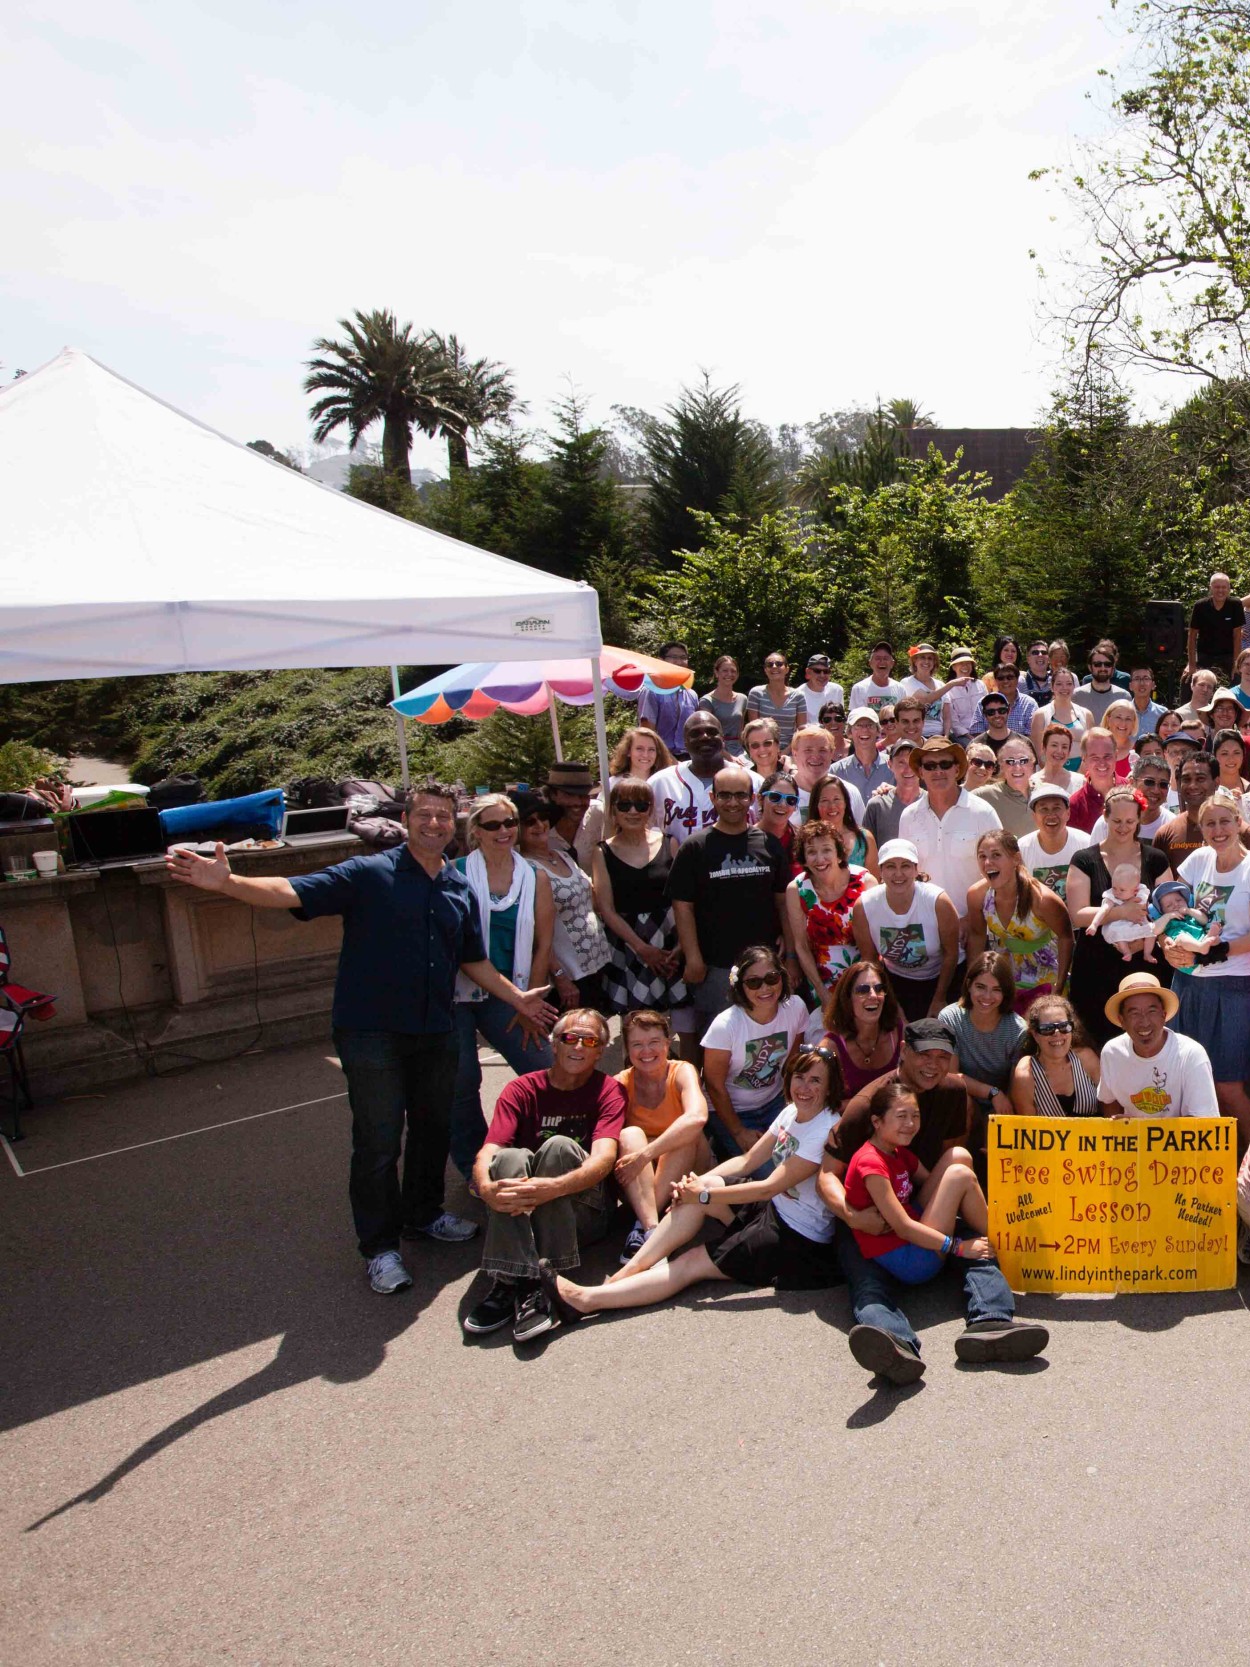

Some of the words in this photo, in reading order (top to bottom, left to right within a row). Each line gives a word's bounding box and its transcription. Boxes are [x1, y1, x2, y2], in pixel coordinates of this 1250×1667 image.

[744, 1040, 773, 1076] LINDY
[997, 1124, 1071, 1151] LINDY
[1146, 1126, 1230, 1151] PARK!!
[1000, 1158, 1050, 1185] Free
[1062, 1159, 1138, 1192] Swing
[1149, 1160, 1224, 1186] Dance
[1017, 1193, 1034, 1207] All
[1069, 1196, 1151, 1223] Lesson
[1175, 1193, 1187, 1206] No
[1191, 1198, 1222, 1216] Partner
[1006, 1202, 1052, 1224] Welcome!
[1177, 1208, 1213, 1227] Needed!
[997, 1232, 1037, 1253] 11AM
[1064, 1235, 1100, 1254] 2PM
[1109, 1236, 1157, 1257] Every
[1165, 1233, 1228, 1255] Sunday!
[1021, 1265, 1197, 1285] www.lindyinthepark.com
